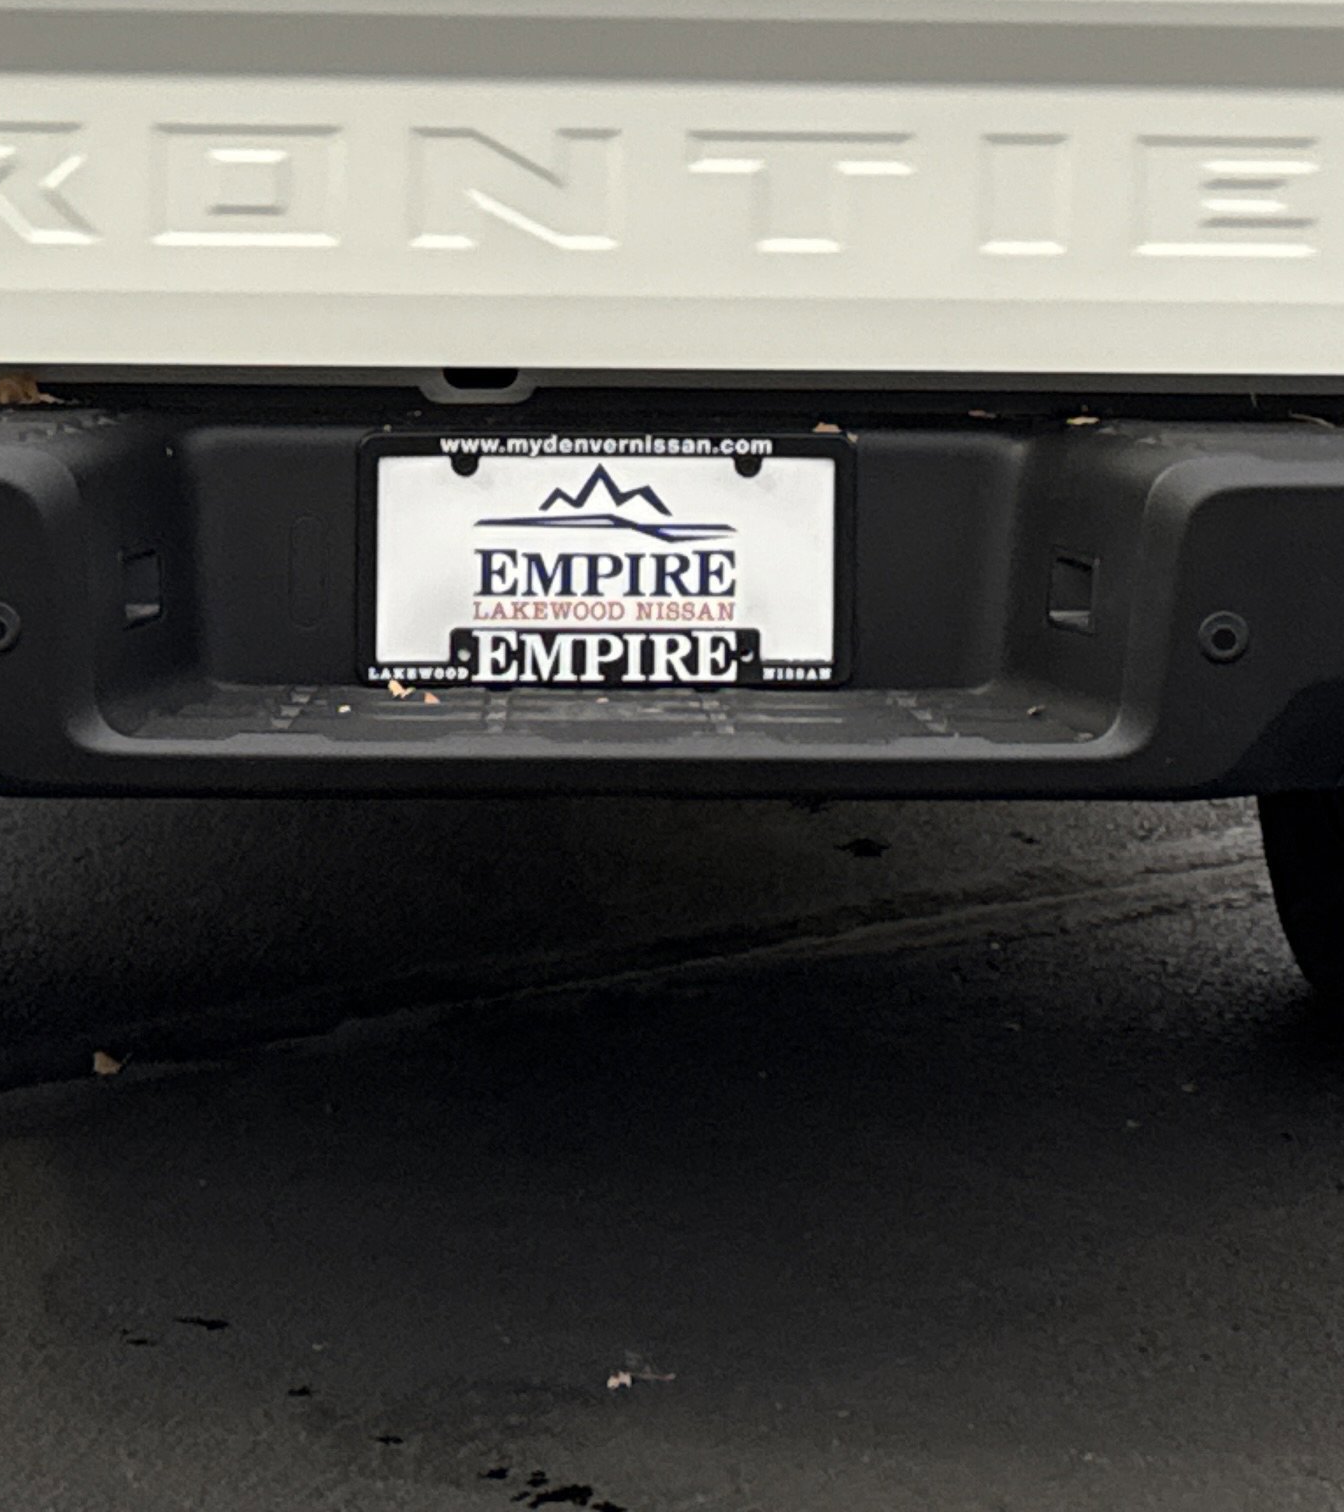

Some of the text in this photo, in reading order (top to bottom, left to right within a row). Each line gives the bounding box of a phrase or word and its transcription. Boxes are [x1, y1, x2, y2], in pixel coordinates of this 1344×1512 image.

[439, 434, 773, 457] www.mydenvernissan.com
[473, 548, 737, 597] EMPIRE
[472, 600, 736, 622] LAKEWOOD NISSAN
[471, 629, 738, 682] EMPIRE
